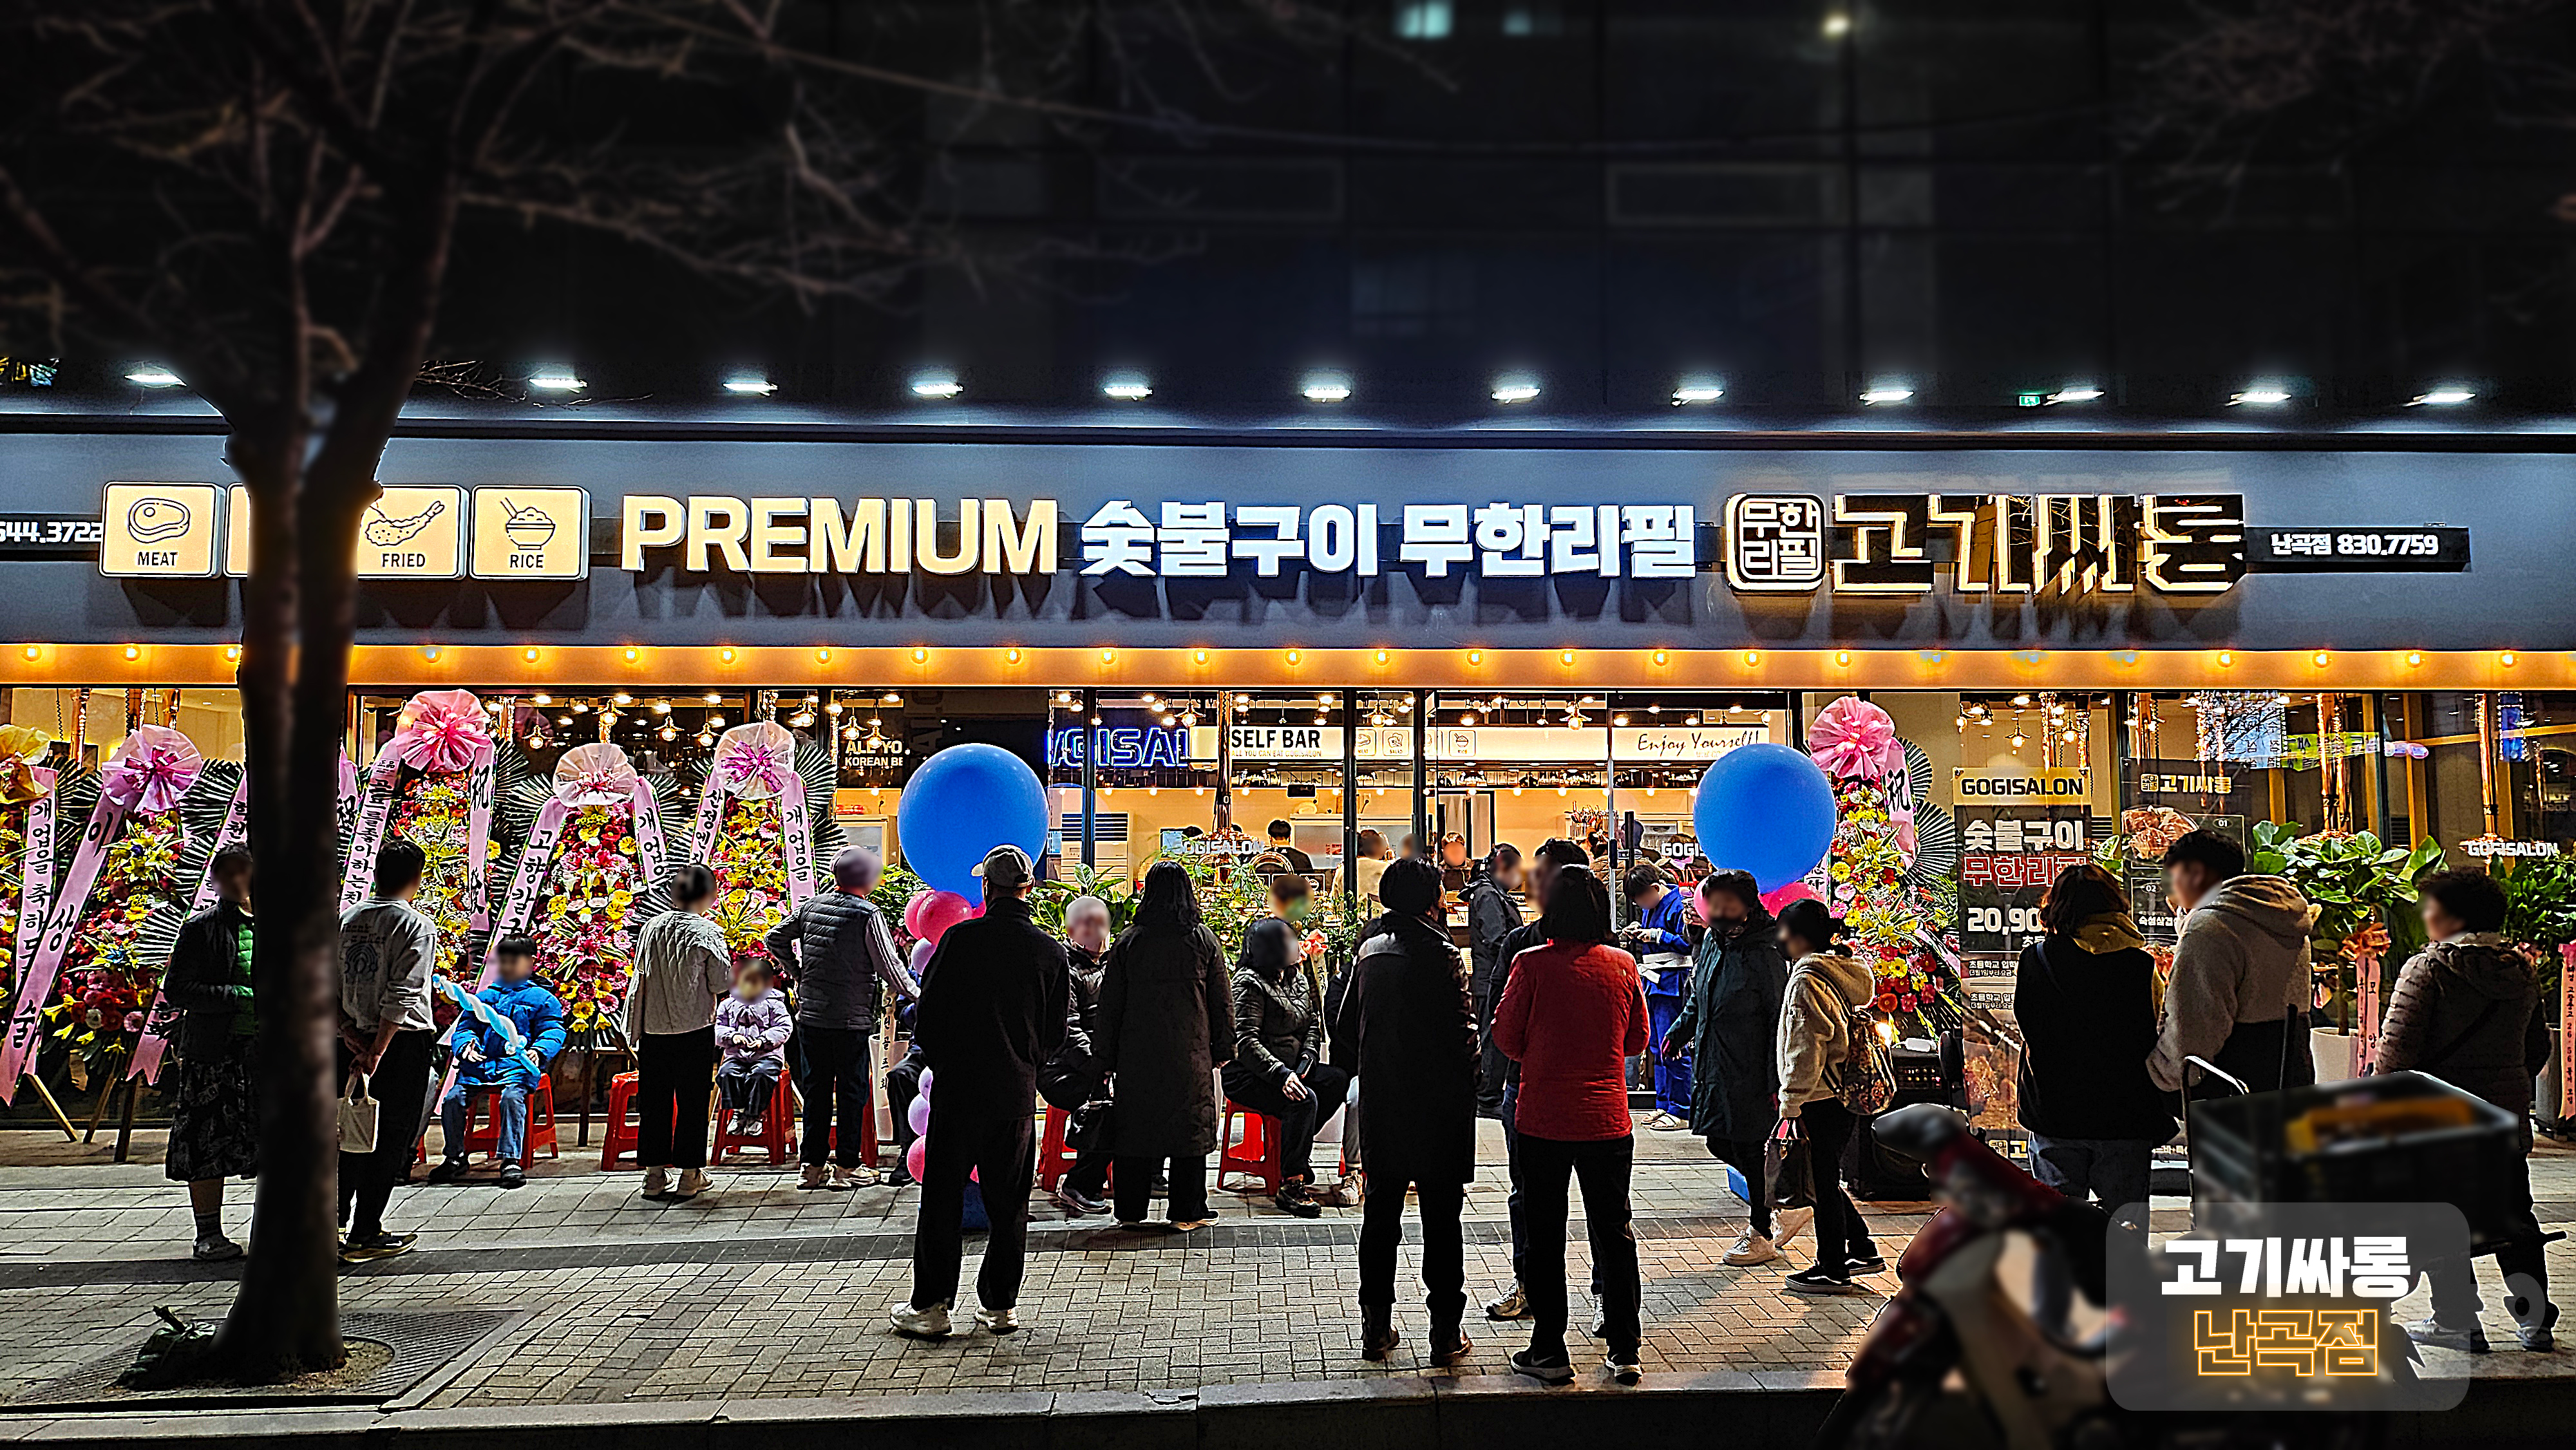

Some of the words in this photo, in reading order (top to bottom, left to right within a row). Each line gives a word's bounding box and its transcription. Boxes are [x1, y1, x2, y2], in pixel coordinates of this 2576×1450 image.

[1743, 502, 1817, 538] 무한
[621, 494, 1058, 575] PREMIUM
[1081, 500, 1378, 578] 숯불구이
[1399, 502, 1696, 578] 무한리필
[2271, 533, 2331, 555] 난곡점
[2337, 534, 2439, 556] 830.7759
[138, 551, 178, 566] MEAT
[381, 553, 426, 568] FRIED
[509, 554, 544, 569] RICE
[1743, 539, 1817, 575] 리필
[1231, 729, 1276, 748] SELF
[1282, 730, 1320, 748] BAR
[1638, 732, 1686, 757] Enjoy
[845, 757, 889, 766] KOREAN
[1886, 767, 1911, 813] 祝
[1961, 778, 2083, 795] GOGISALON
[2159, 775, 2232, 794] 고기싸롱
[1964, 819, 2085, 851] 숯불구이
[2138, 915, 2177, 927] 숙성삼겹
[1969, 961, 2000, 969] 초등학교
[1970, 993, 2001, 1002] 초등학교
